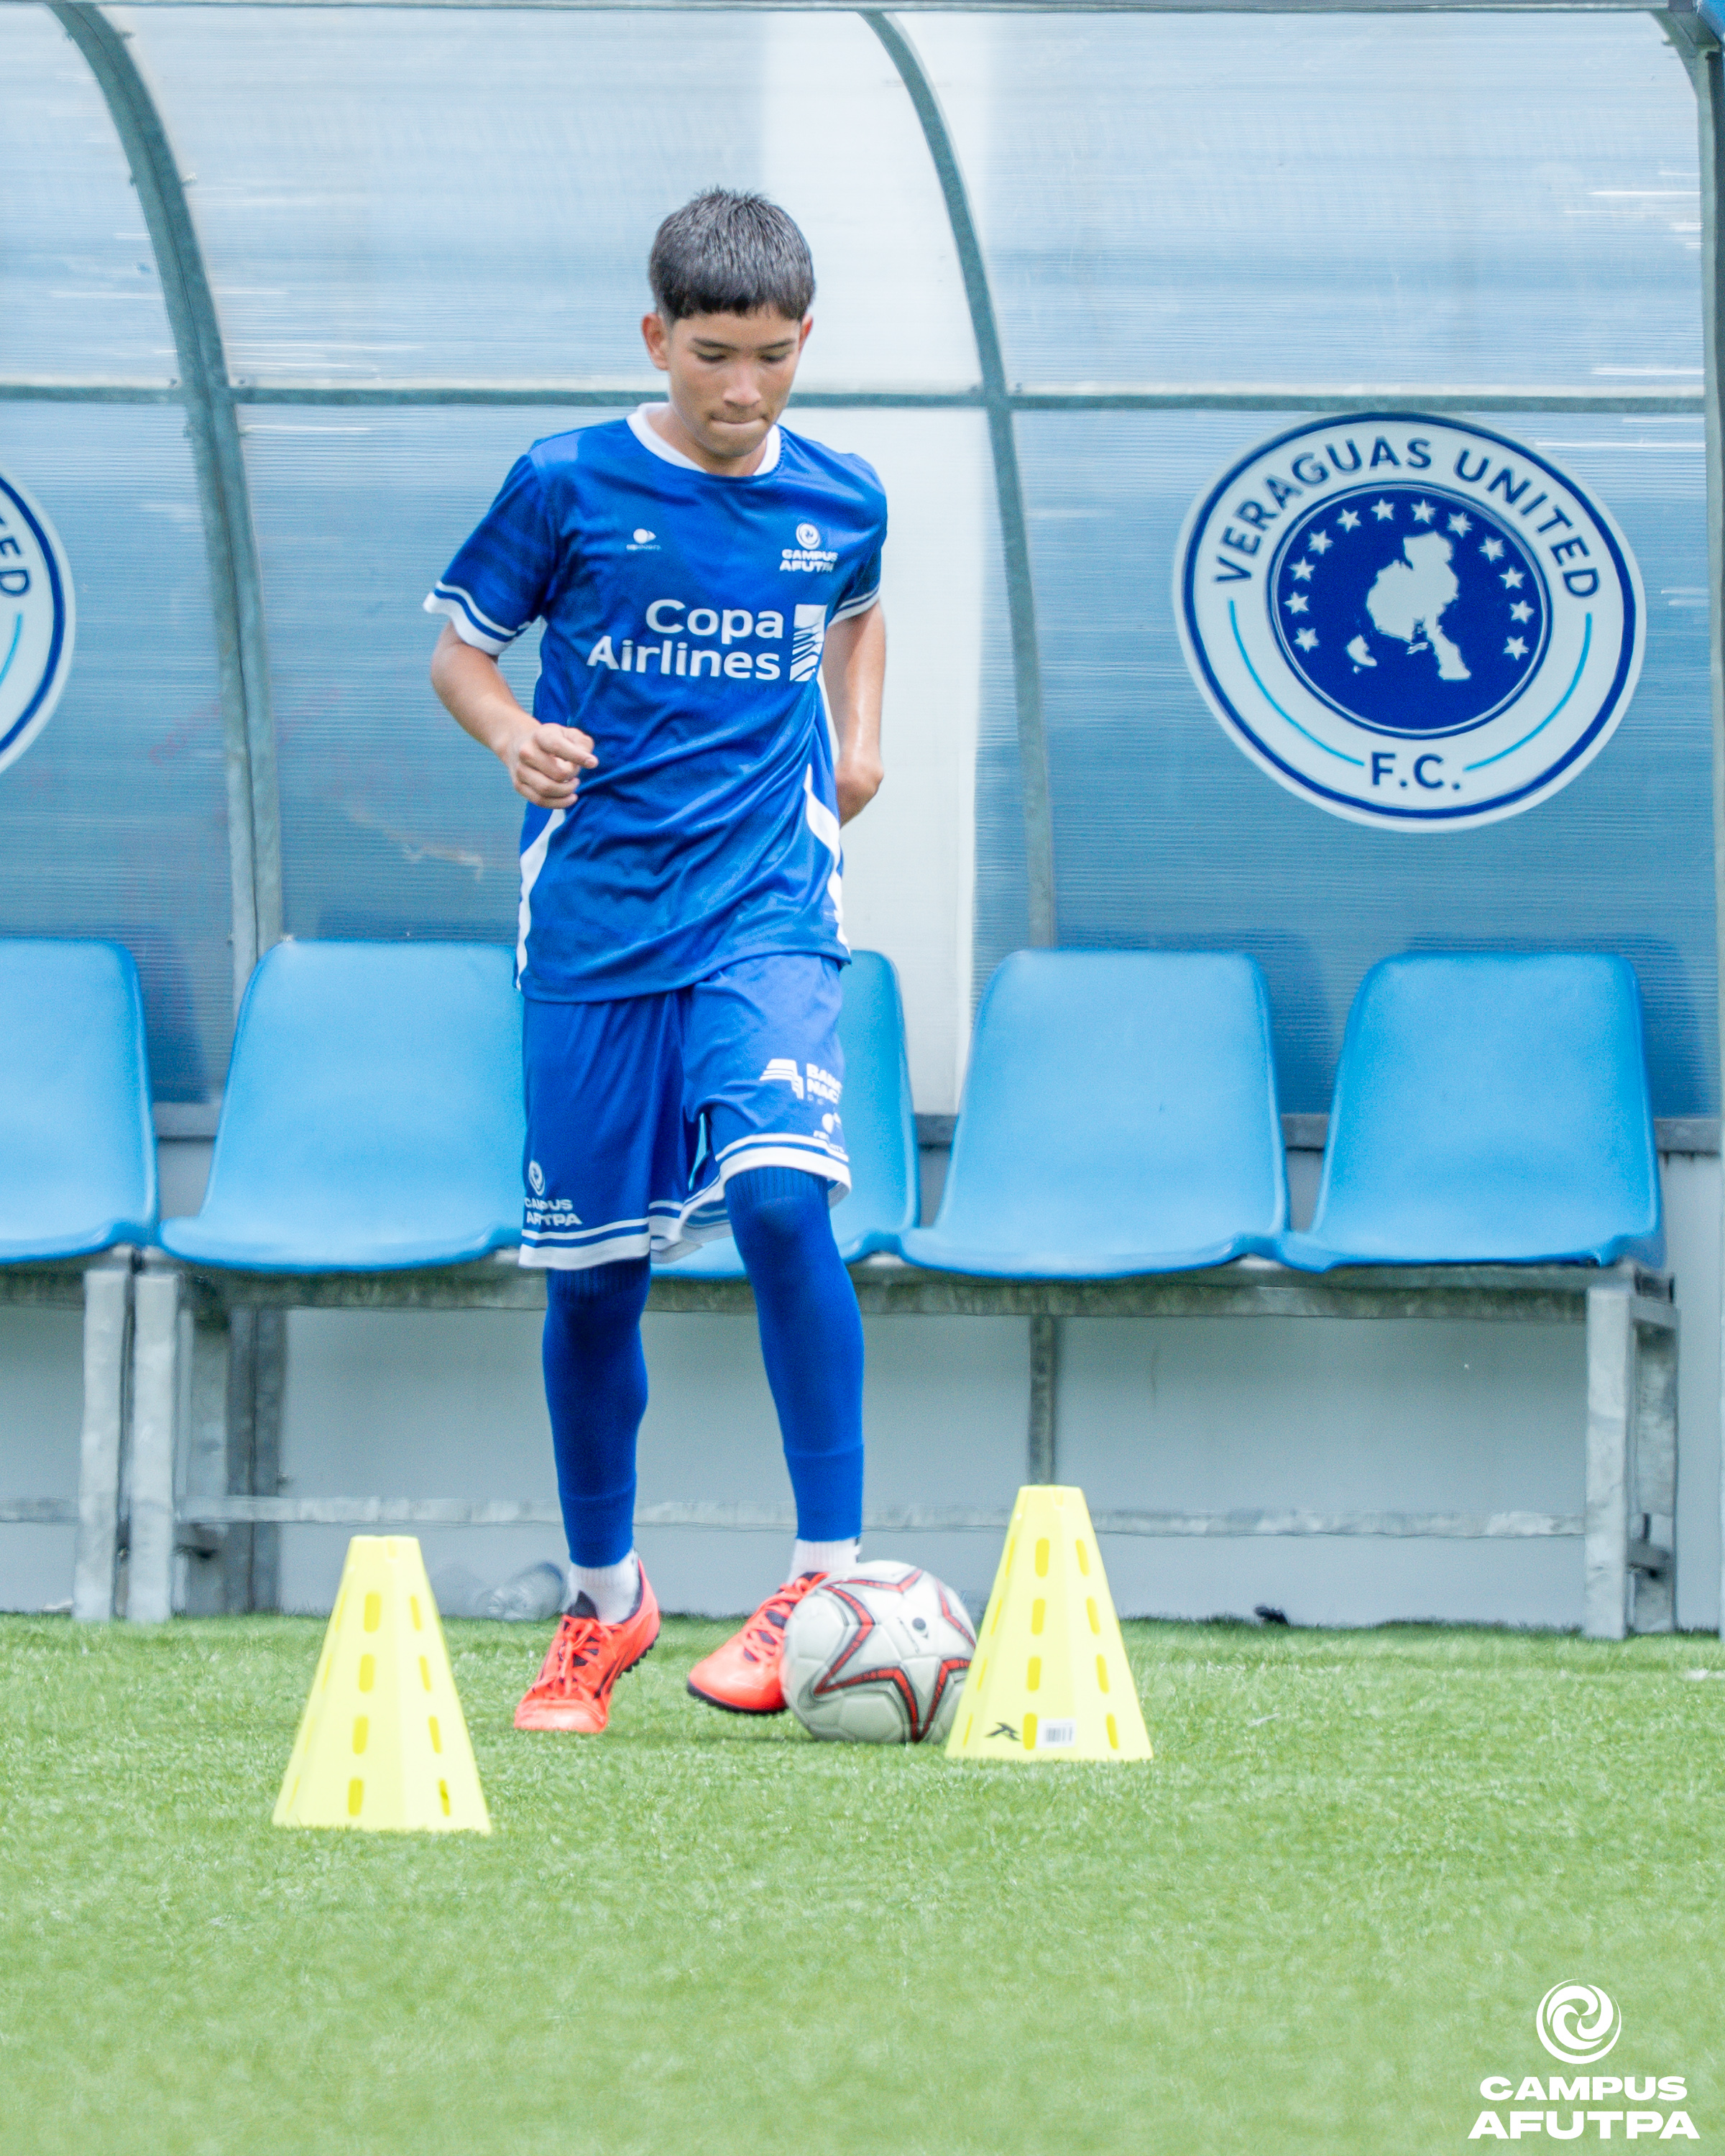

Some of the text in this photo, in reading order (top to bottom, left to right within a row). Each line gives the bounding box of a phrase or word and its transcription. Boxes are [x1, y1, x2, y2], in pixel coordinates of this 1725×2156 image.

[1215, 436, 1601, 599] VERAGUAS UNITED
[0, 513, 30, 596] ED
[782, 548, 838, 562] CAMPUS
[646, 599, 784, 645] Copa
[586, 635, 781, 681] Airlines
[1371, 751, 1461, 791] F.C.
[526, 1211, 583, 1227] AFTPA
